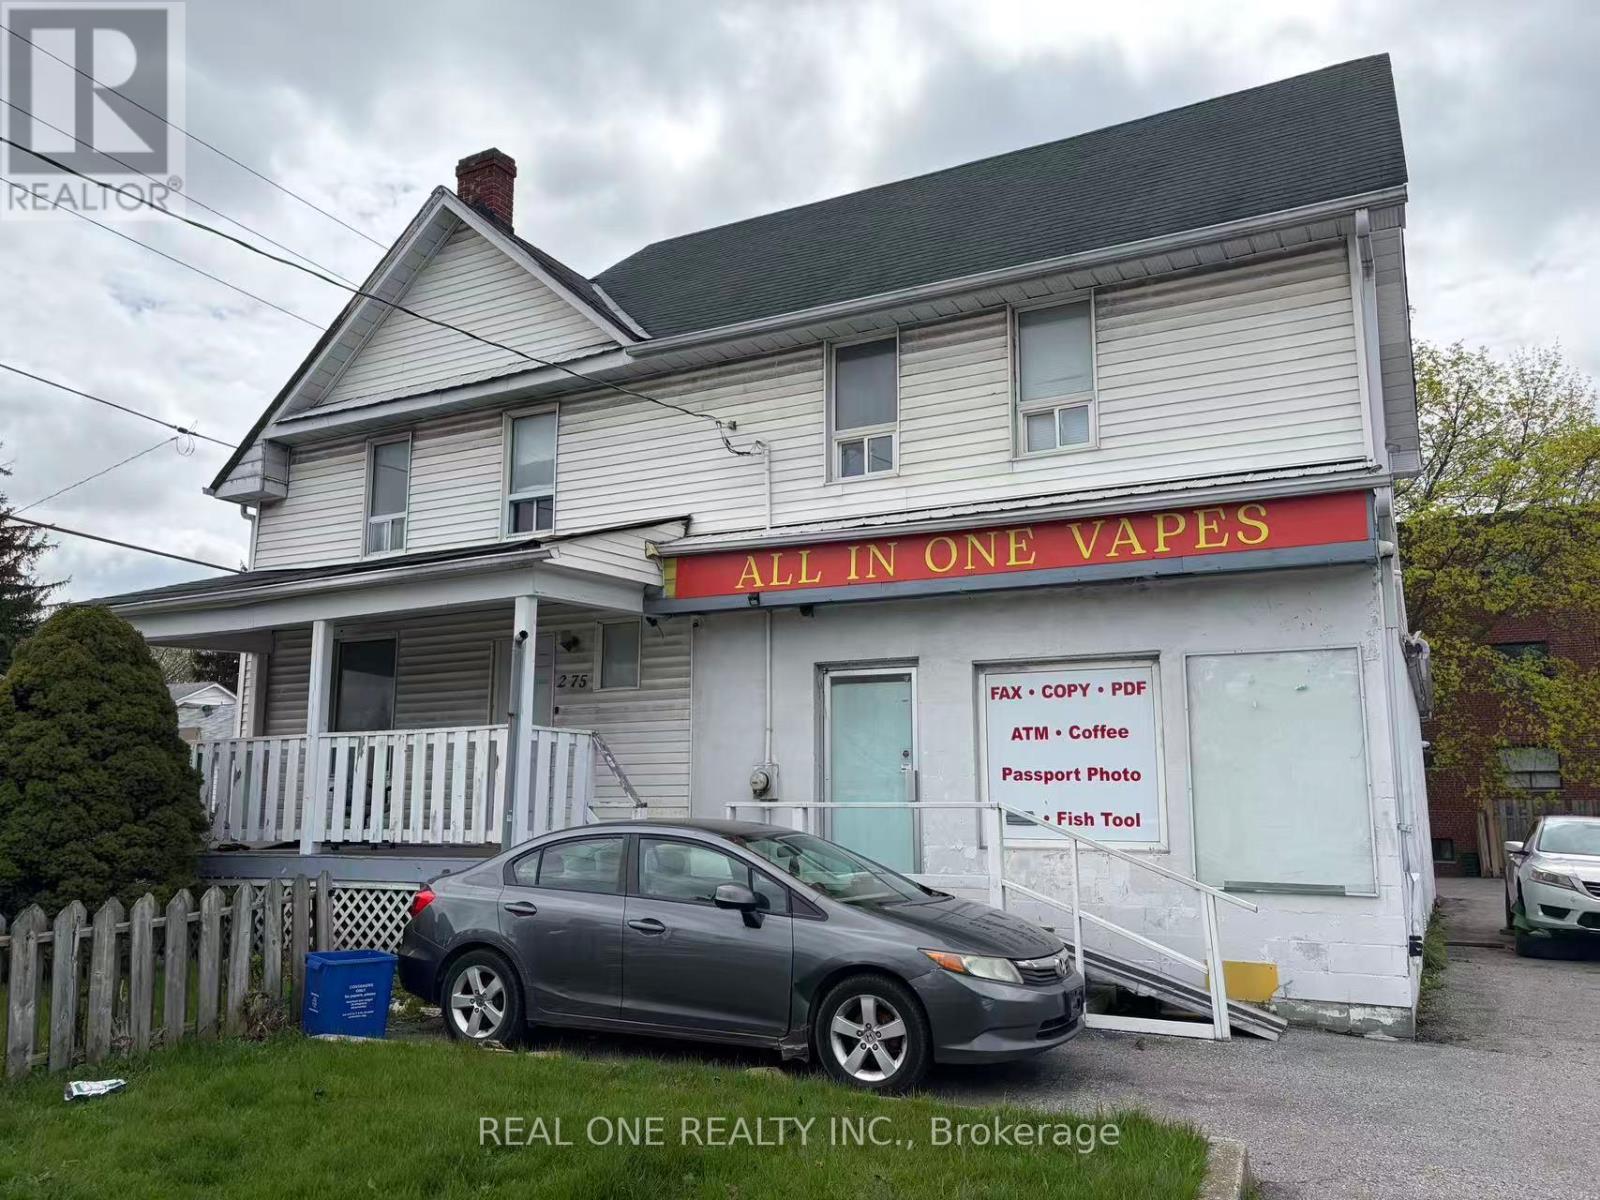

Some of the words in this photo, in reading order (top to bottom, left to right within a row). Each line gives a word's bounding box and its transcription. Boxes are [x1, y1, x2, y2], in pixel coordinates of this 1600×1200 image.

[734, 550, 822, 589] ALL
[847, 542, 898, 580] IN
[924, 527, 1036, 574] ONE
[1066, 503, 1270, 560] VAPES
[556, 674, 588, 689] 275
[990, 685, 1022, 700] FAX
[1041, 683, 1090, 699] COPY
[1111, 681, 1147, 696] PDF
[1011, 726, 1049, 741] ATM
[1068, 724, 1129, 740] Coffee
[1002, 767, 1081, 784] Passport
[1087, 767, 1142, 782] Photo
[1057, 811, 1094, 826] Fish
[1101, 812, 1141, 827] Tool
